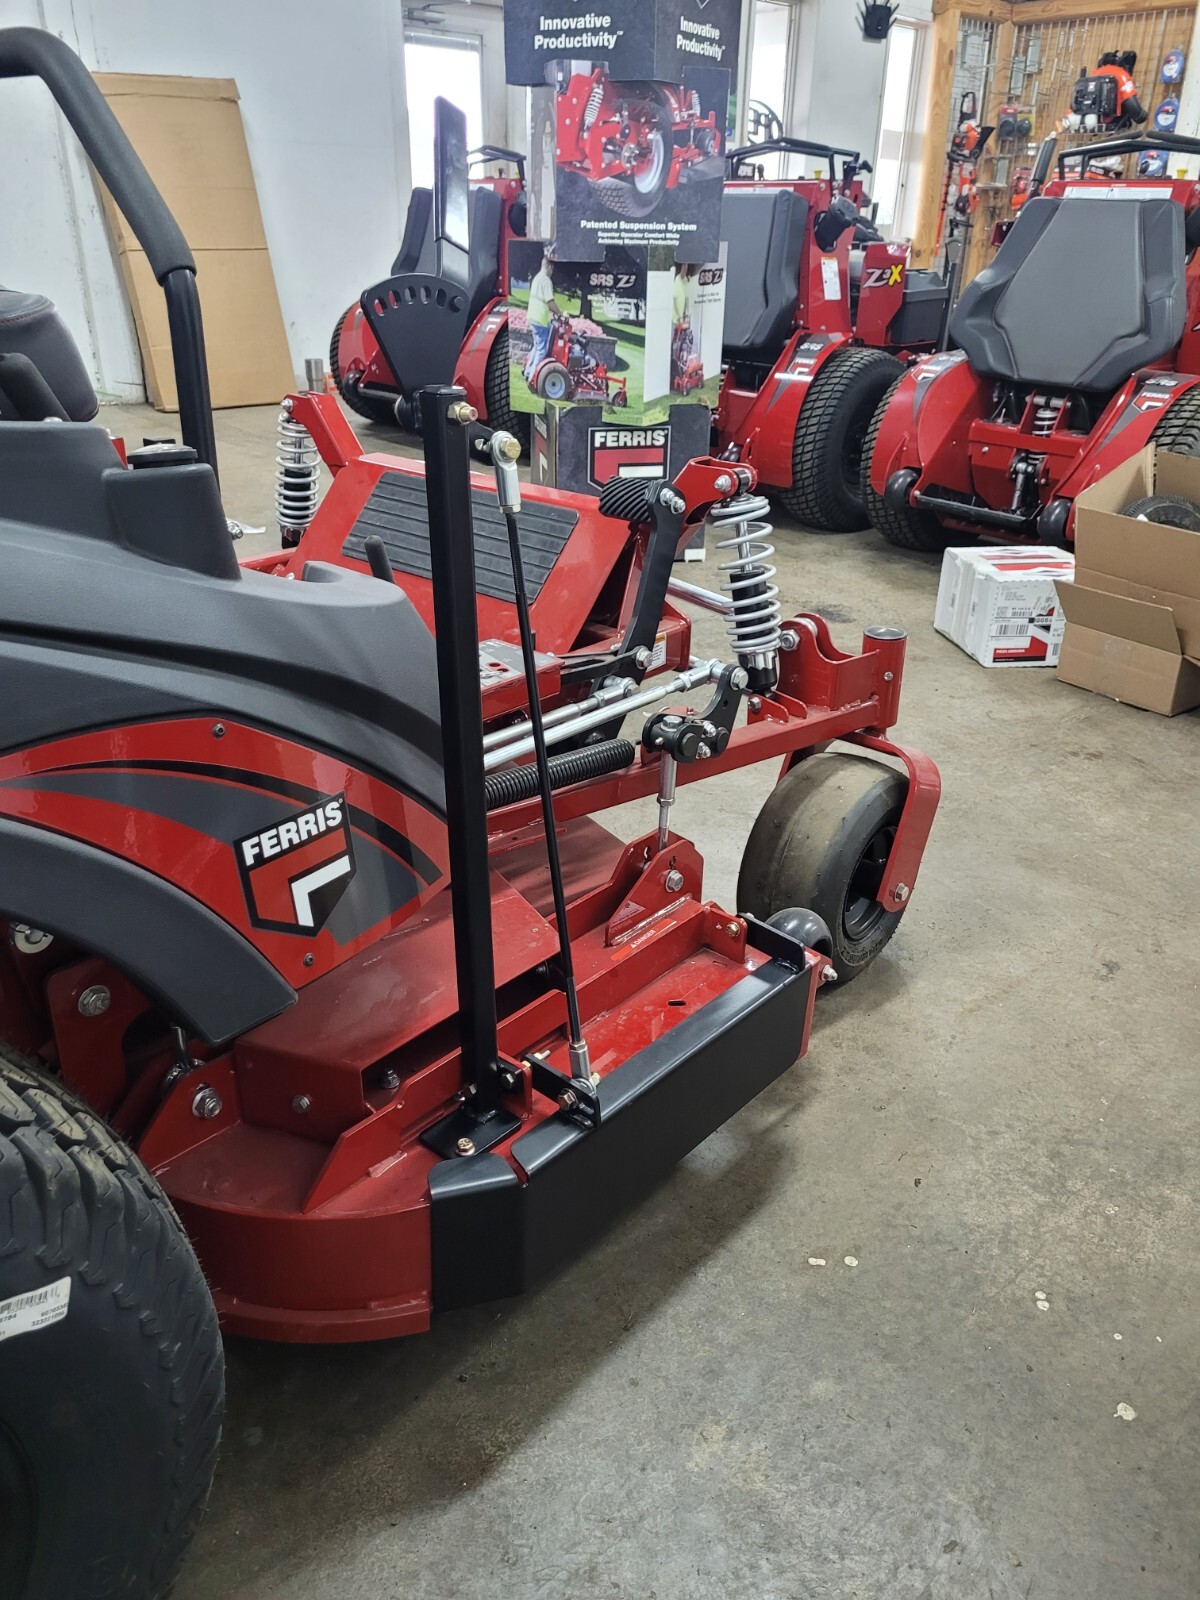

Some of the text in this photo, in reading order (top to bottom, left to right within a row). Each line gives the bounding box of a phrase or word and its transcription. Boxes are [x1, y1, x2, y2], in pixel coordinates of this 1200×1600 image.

[540, 13, 611, 31] Innovative
[680, 16, 720, 40] Innovative
[580, 220, 697, 232] Patented Suspension System
[597, 231, 620, 239] Superior
[589, 273, 614, 287] SRS
[594, 430, 666, 448] FERRIS
[241, 800, 343, 867] FERRIS
